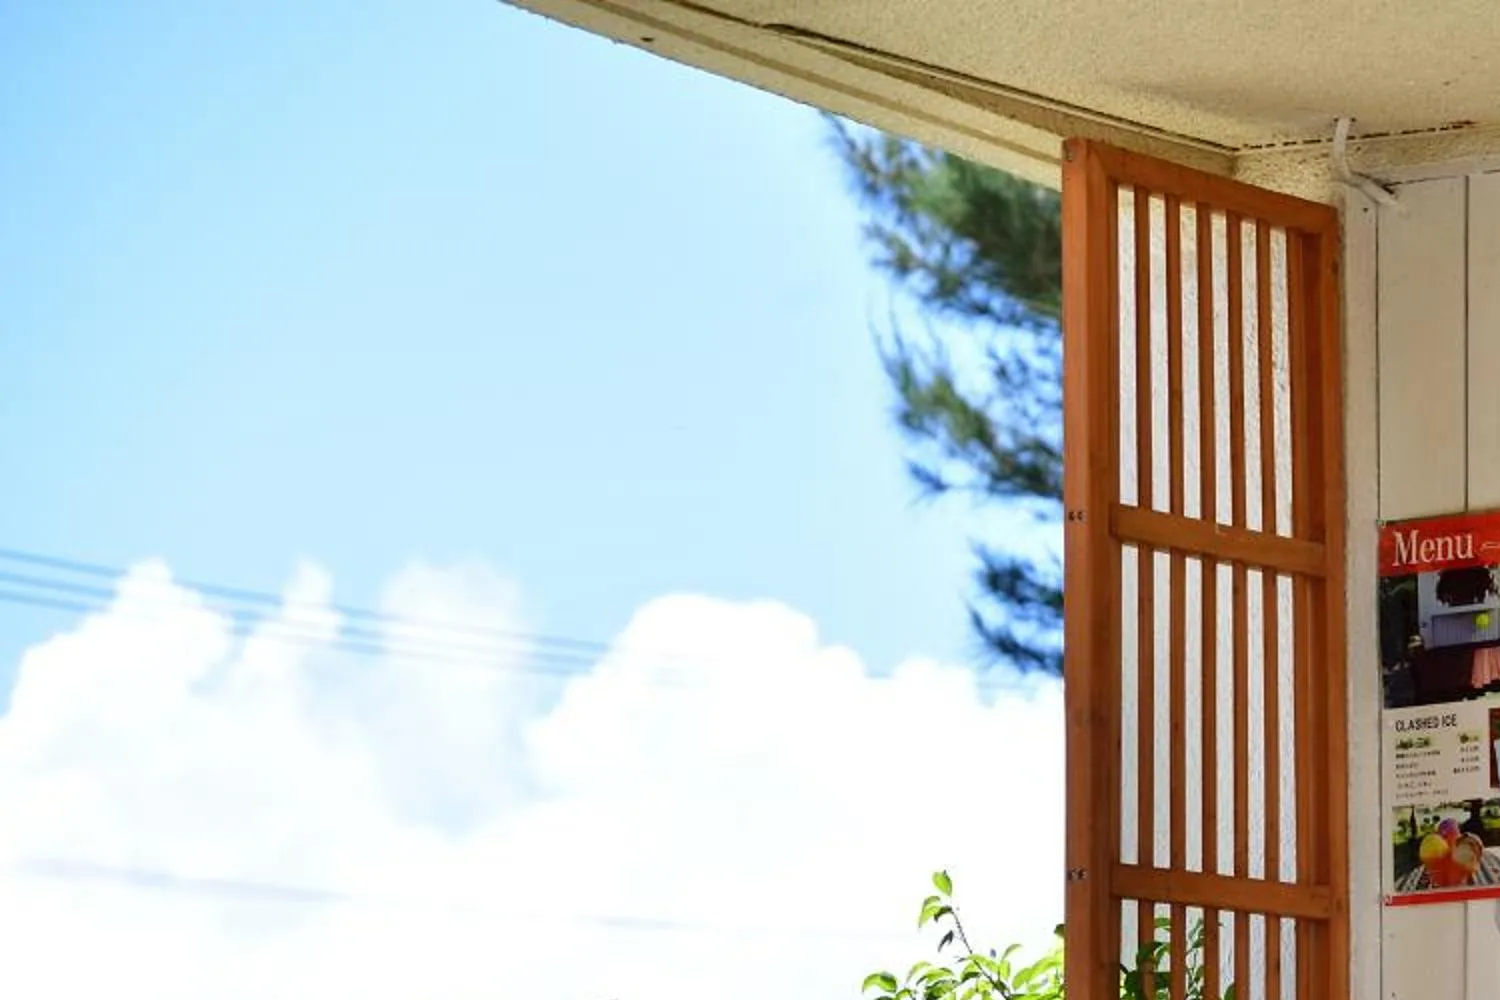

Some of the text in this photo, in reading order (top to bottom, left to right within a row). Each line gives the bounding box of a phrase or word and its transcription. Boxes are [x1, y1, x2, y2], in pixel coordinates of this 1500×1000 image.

[1391, 528, 1475, 567] Menu
[1395, 713, 1457, 733] CLASHED ICE
